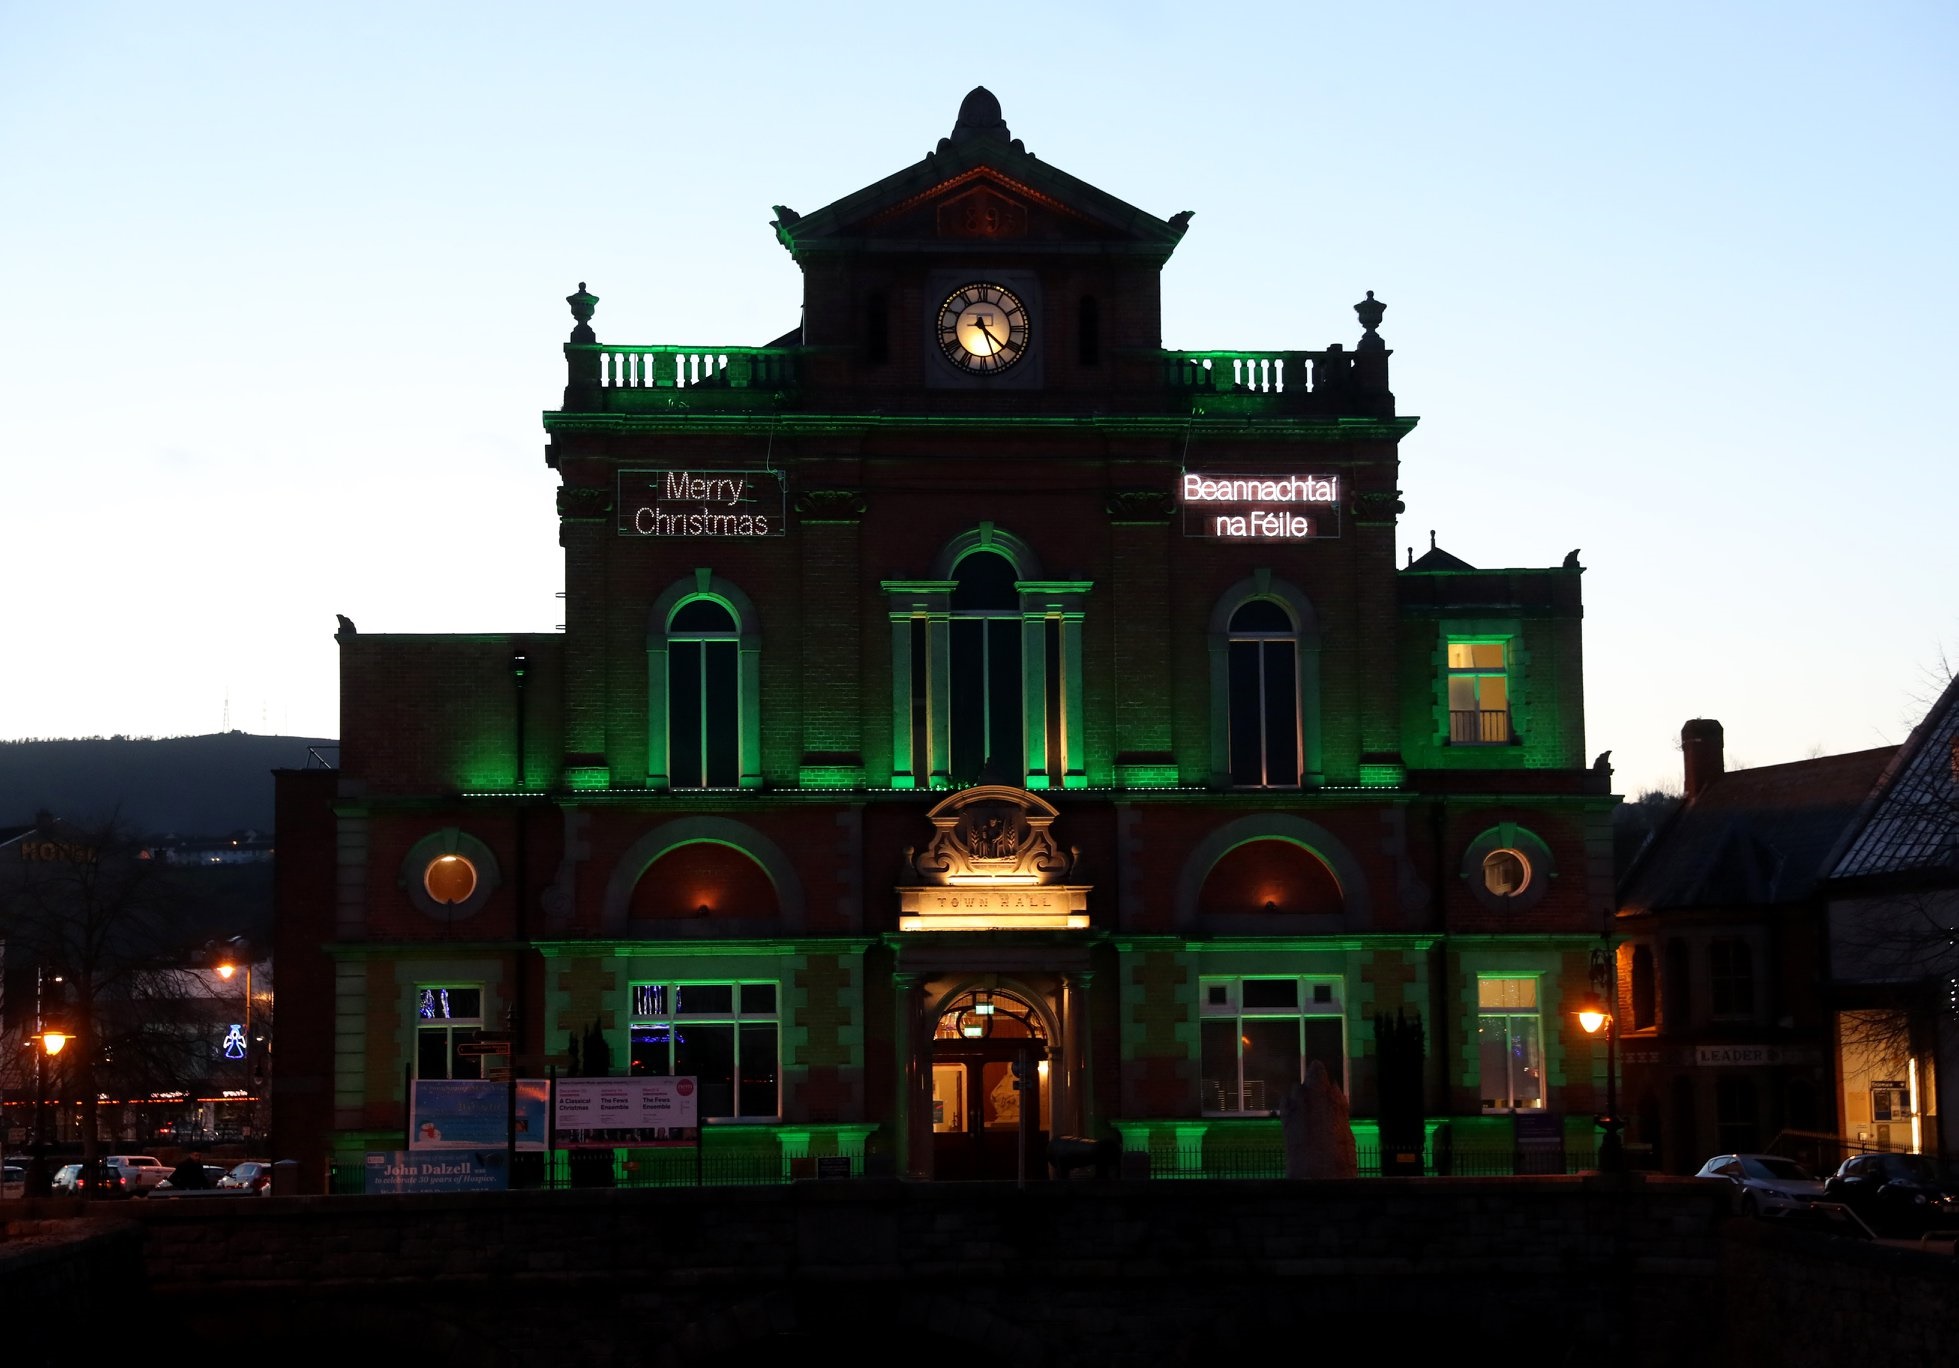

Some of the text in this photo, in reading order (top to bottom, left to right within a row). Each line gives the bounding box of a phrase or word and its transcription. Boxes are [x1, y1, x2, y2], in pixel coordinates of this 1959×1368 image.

[666, 471, 744, 506] Merry
[1183, 473, 1337, 502] Beannachtaí
[635, 506, 769, 536] Christmas
[1216, 511, 1308, 538] na Féile
[937, 896, 1052, 908] TOWN HALL
[1700, 1049, 1762, 1062] LEADER
[384, 1164, 418, 1176] John
[422, 1162, 471, 1175] Dalzell
[383, 1175, 417, 1184] celebrate
[430, 1176, 452, 1184] years
[453, 1175, 463, 1184] of
